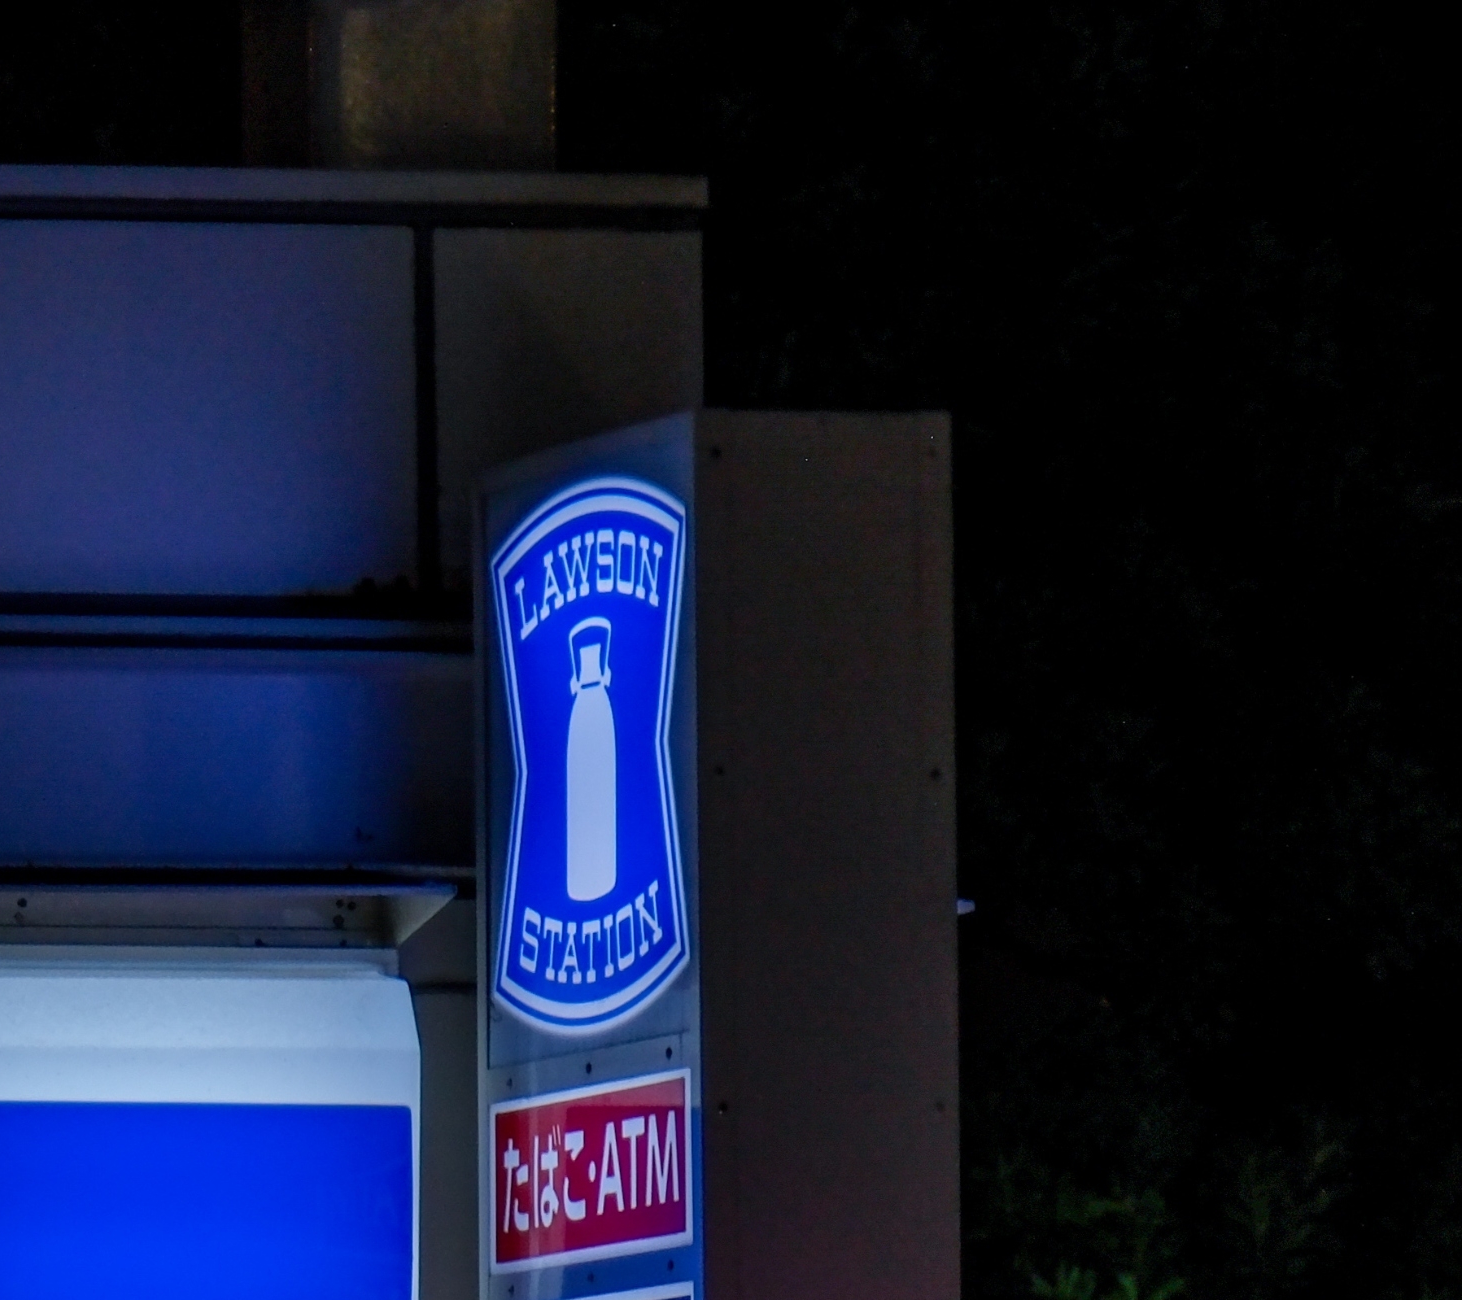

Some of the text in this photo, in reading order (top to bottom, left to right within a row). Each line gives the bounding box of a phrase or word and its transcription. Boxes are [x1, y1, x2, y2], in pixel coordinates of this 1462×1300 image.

[513, 529, 663, 641] LAWSON
[519, 880, 662, 986] STATION
[502, 1110, 681, 1236] たばこ・ATM
